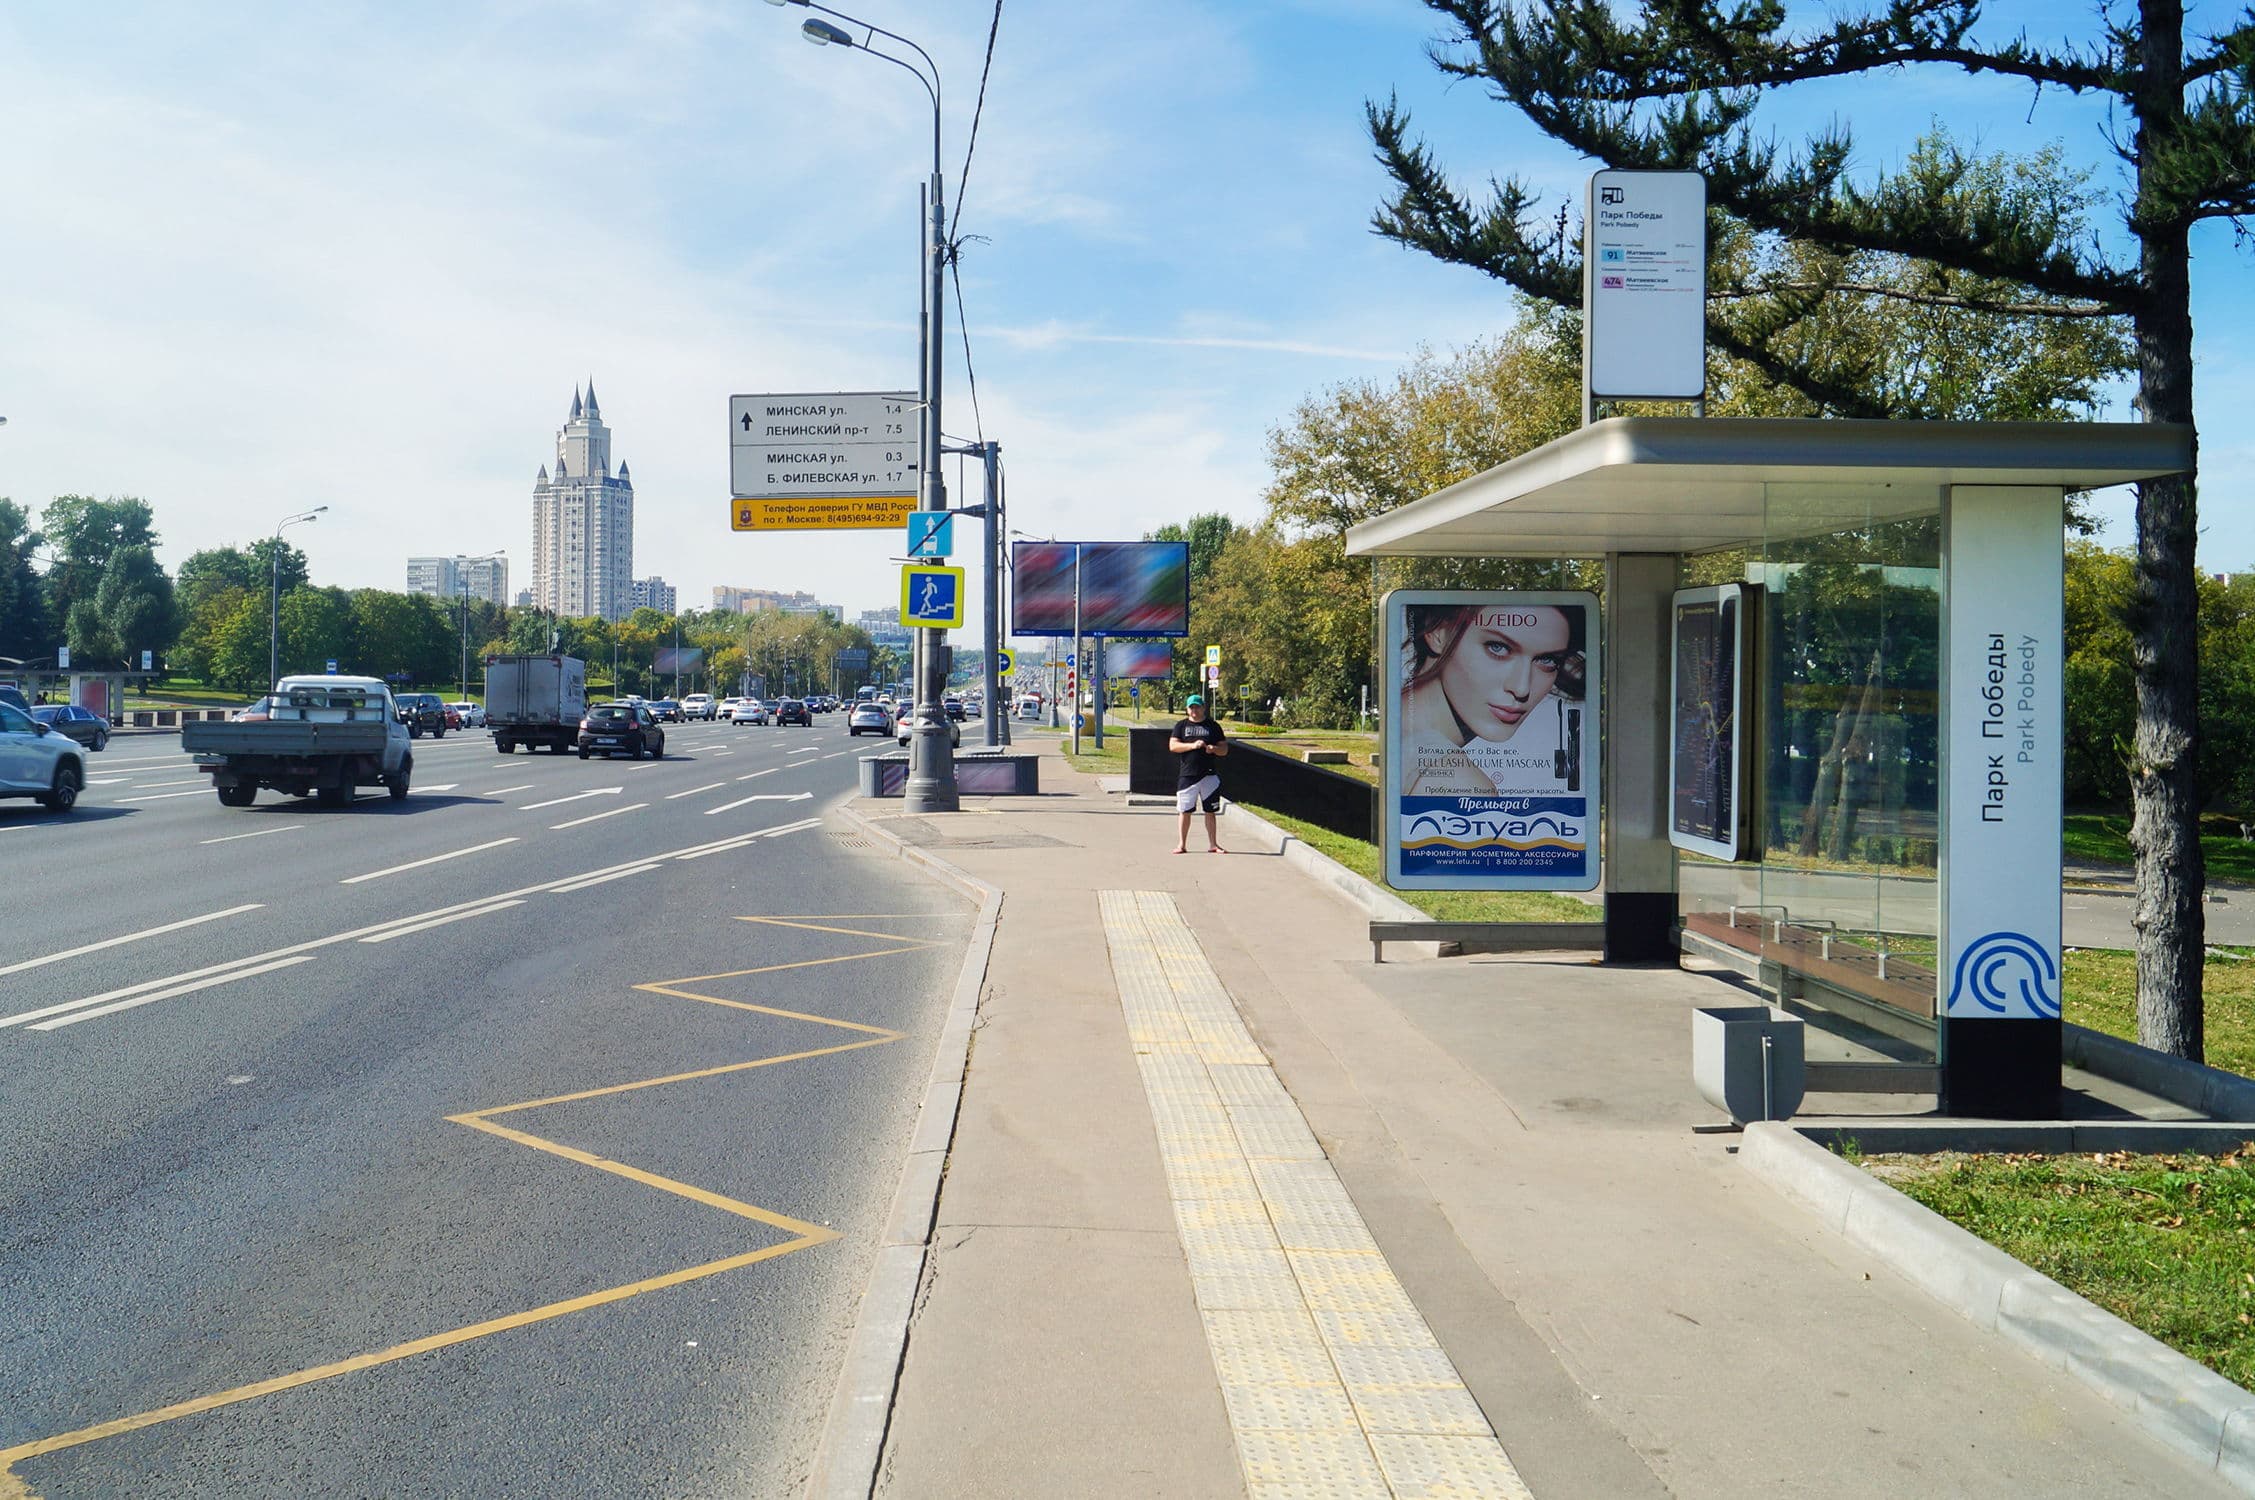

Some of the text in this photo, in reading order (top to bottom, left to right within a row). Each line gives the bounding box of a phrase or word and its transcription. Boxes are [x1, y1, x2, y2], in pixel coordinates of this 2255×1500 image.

[1600, 211, 1663, 220] Парк Победы
[1607, 251, 1619, 260] 91
[1604, 277, 1622, 286] 474
[766, 405, 902, 417] МИНСКАЯ ул. 1.4
[766, 424, 903, 436] ЛЕНИНСКИЙ пр-т 7.5
[767, 452, 903, 465] МИНСКАЯ ул. 0.3
[767, 472, 903, 484] Б. ФИЛЕВСКАЯ ул. 1.7
[763, 504, 806, 513] Телефон
[808, 504, 849, 513] доверия
[852, 503, 863, 512] ГУ
[866, 503, 888, 512] МВД
[763, 513, 901, 524] по г. Москве: 8(495)694-92-29
[1471, 614, 1538, 627] HISEIDO
[2017, 635, 2039, 763] Park Pobedy
[1981, 634, 2009, 822] Парк Победы
[1418, 747, 1445, 755] Взгляд
[1486, 747, 1501, 755] Вас
[1418, 758, 1439, 768] FULL
[1440, 758, 1465, 768] LASH
[1466, 758, 1503, 768] VOLUME
[1425, 786, 1473, 795] Пробуждение
[1474, 786, 1497, 794] Вашей
[1498, 786, 1535, 795] природной
[1458, 797, 1530, 812] Премьера в
[1409, 850, 1579, 859] ПАРФЮМЕРИЯ КОСМЕТИКА АКСЕССУАРЫ
[1503, 858, 1518, 866] 800
